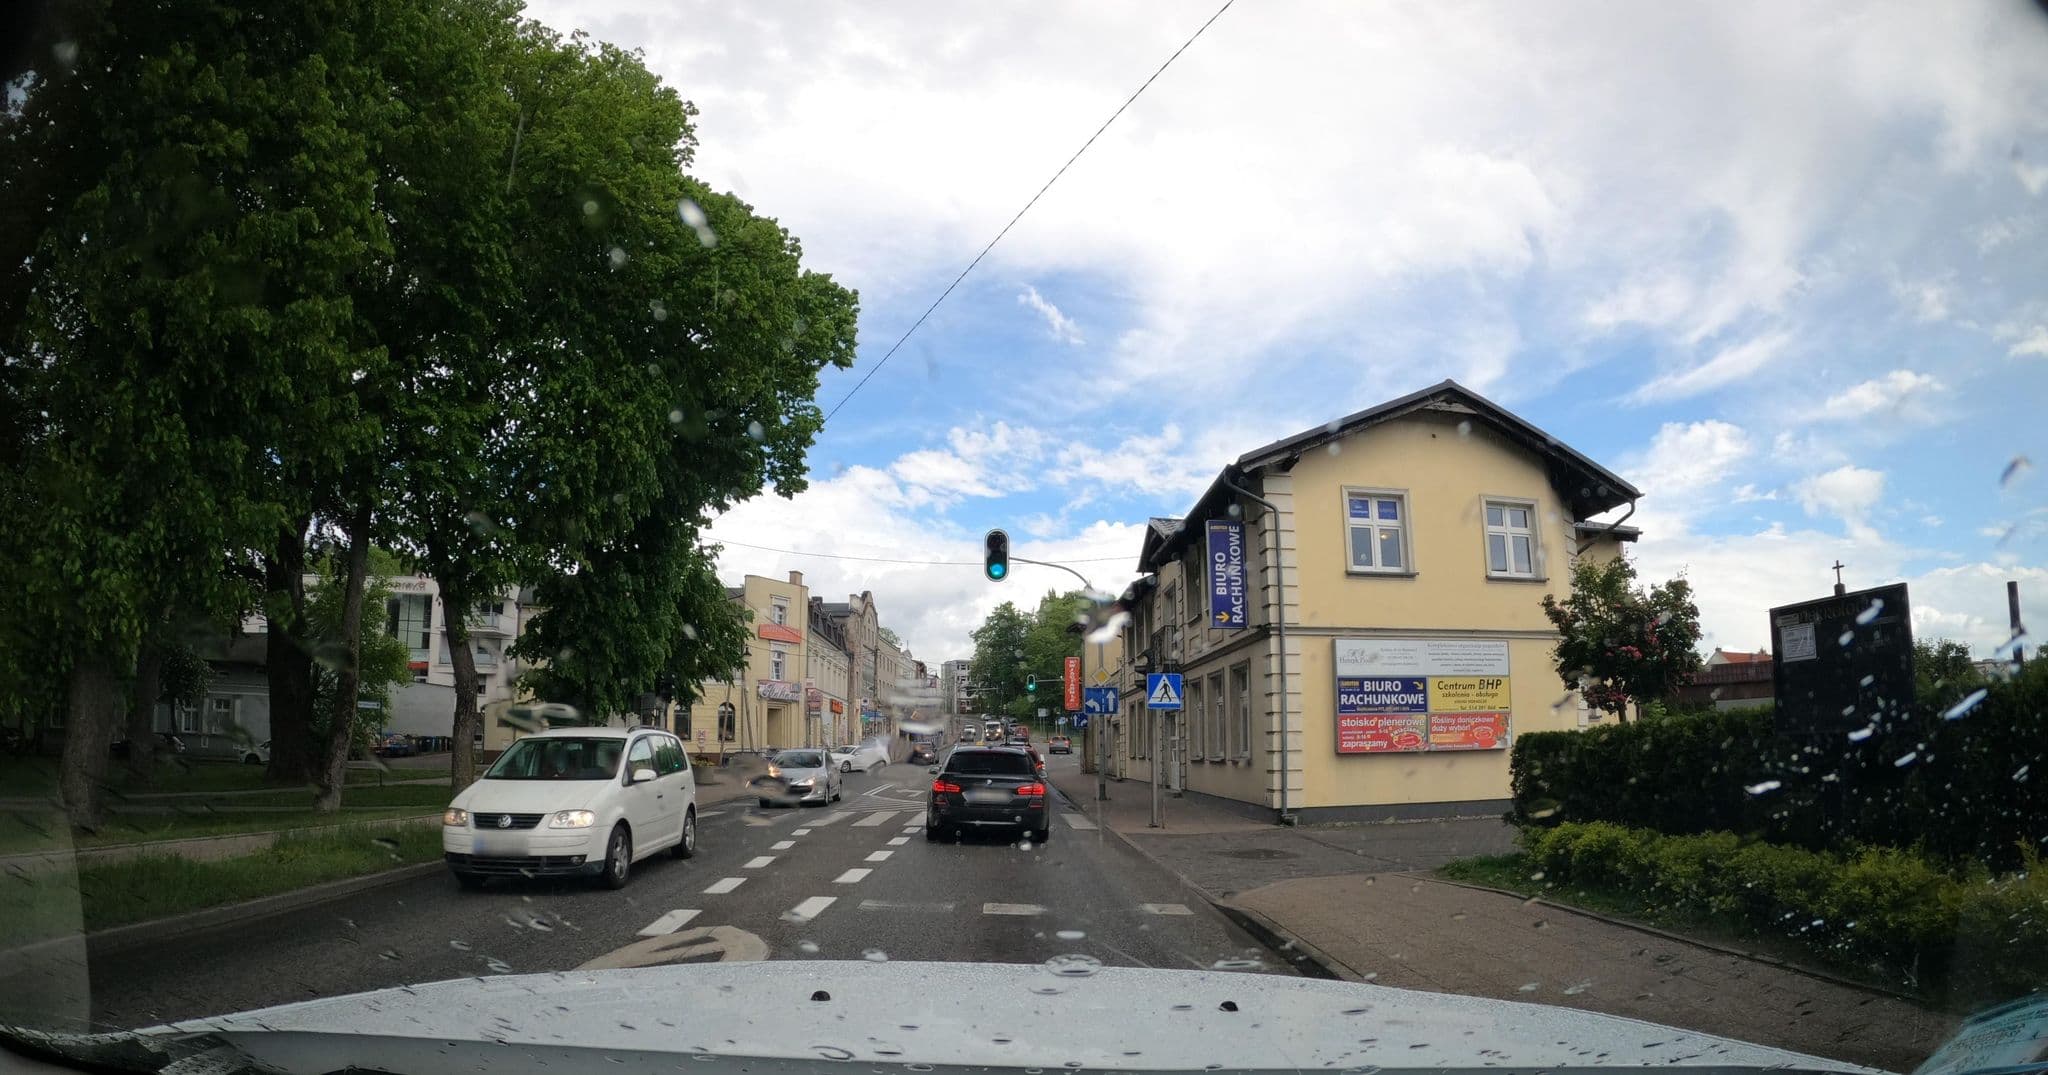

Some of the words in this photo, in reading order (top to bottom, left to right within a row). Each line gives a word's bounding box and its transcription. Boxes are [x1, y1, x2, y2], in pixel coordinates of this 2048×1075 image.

[1215, 552, 1227, 595] BIURO
[1229, 525, 1243, 623] RACHUNKOWE
[1363, 680, 1402, 692] BIURO
[1437, 680, 1476, 690] Centrum
[1478, 679, 1502, 690] BHP
[1340, 694, 1425, 705] RACHUNKOWE
[1341, 717, 1376, 727] stoisko
[1378, 717, 1425, 728] plenerowe
[1431, 716, 1456, 725] Rośliny
[1342, 740, 1388, 749] zapraszamy
